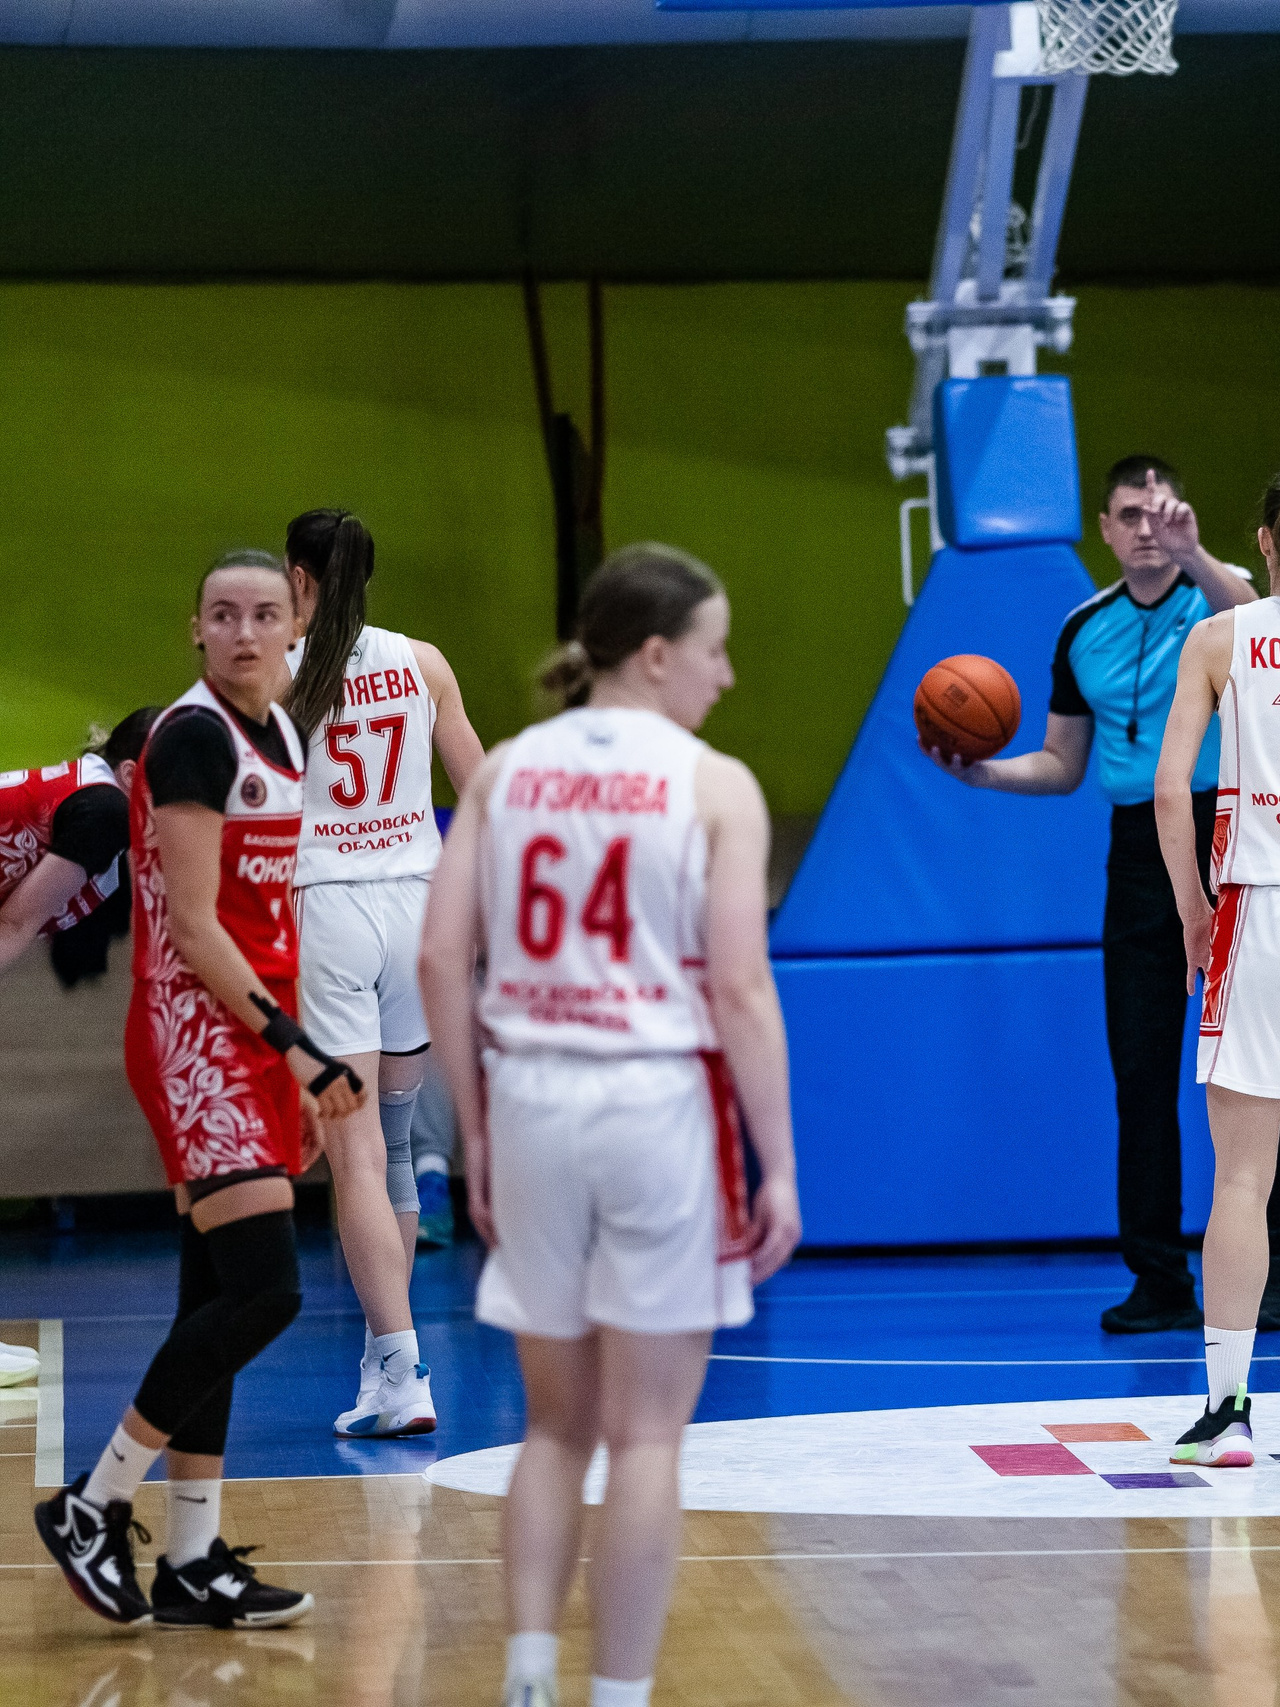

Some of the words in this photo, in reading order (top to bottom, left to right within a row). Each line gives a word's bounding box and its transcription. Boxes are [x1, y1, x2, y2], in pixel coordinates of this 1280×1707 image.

[324, 712, 408, 810] 57
[337, 831, 413, 855] ОБЛАСТЬ
[516, 833, 633, 963] 64
